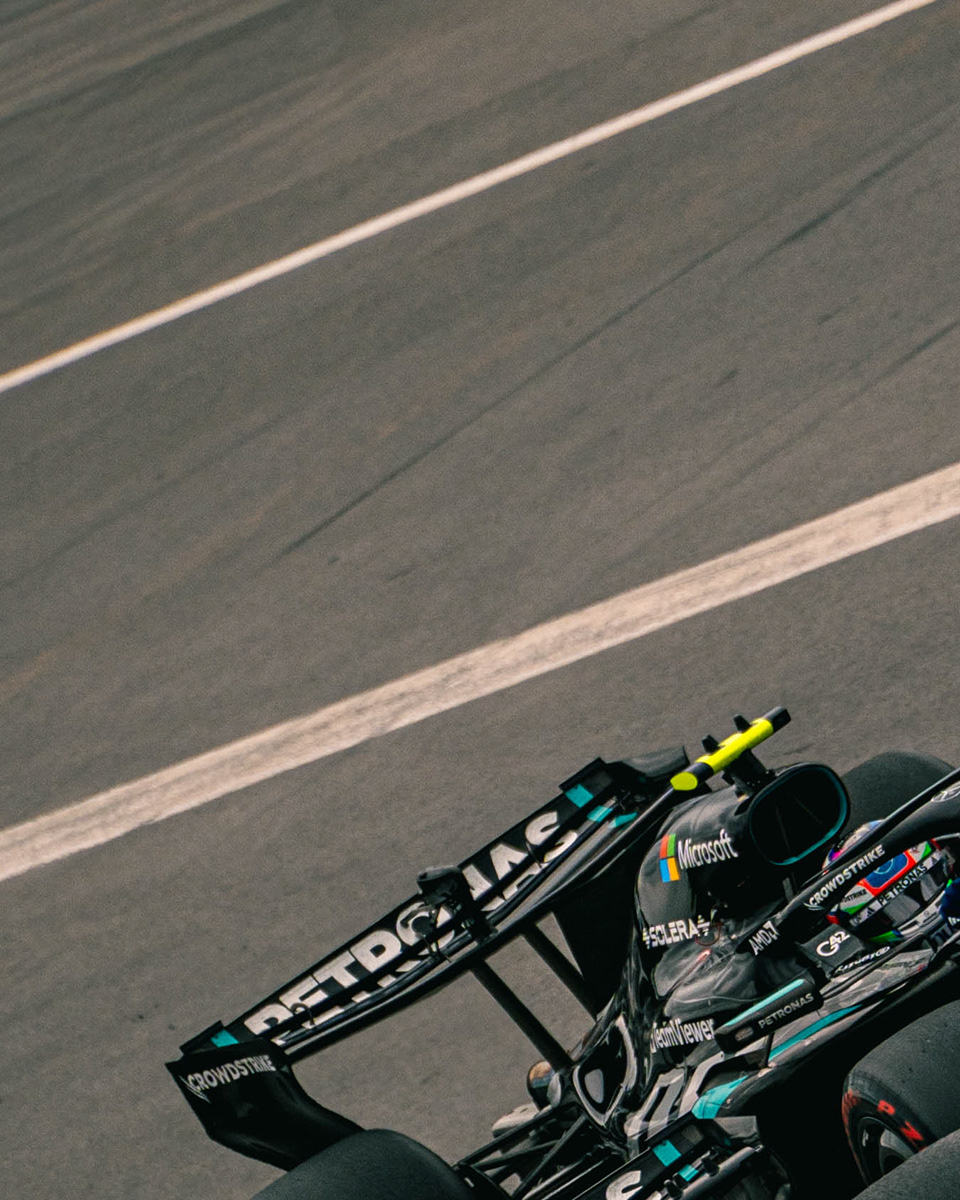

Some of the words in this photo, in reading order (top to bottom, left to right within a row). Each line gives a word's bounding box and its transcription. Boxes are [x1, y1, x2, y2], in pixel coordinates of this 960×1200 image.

[677, 828, 739, 870] Microsoft
[808, 844, 886, 907] CROWDSTRIKE
[749, 929, 772, 955] AMD
[816, 930, 850, 957] G42
[757, 992, 815, 1029] PETRONAS
[187, 1055, 277, 1093] CROWDSTRIKE
